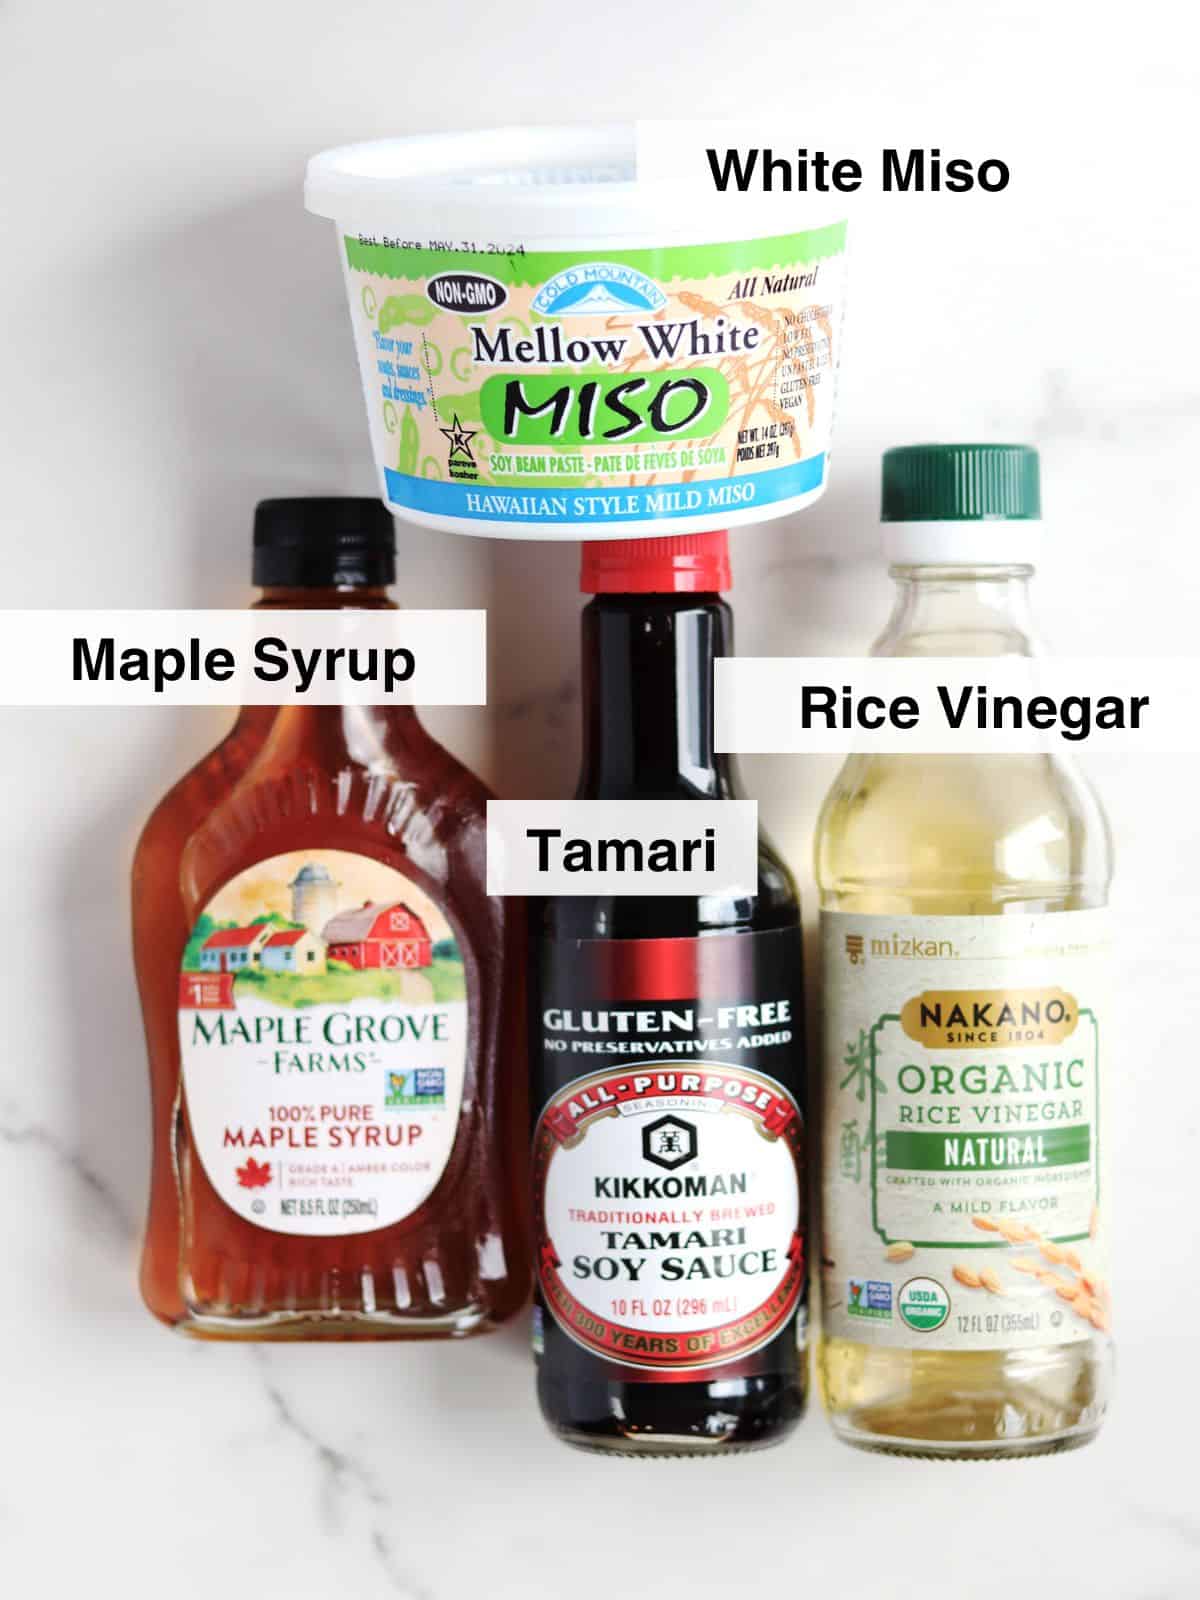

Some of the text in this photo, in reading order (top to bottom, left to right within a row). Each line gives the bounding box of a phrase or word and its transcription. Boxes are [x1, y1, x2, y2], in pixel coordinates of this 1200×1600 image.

[359, 233, 525, 257] Best Before MAY.31.2024
[435, 280, 497, 305] NON-GMO
[538, 267, 663, 308] COLD MOUNTAIN
[727, 265, 819, 300] All Natural
[471, 326, 628, 363] Mellow
[638, 318, 759, 359] White
[780, 378, 807, 394] GLUTEN
[504, 378, 710, 438] MISO
[779, 395, 802, 409] VEGAN
[454, 433, 464, 446] K
[490, 454, 513, 473] SOY
[516, 455, 546, 473] BEAN
[554, 455, 585, 473] PASTE
[594, 455, 622, 472] PATE
[626, 454, 640, 471] DE
[681, 451, 695, 467] DE
[699, 447, 726, 465] SOYA
[466, 483, 755, 516] HAWAIIAN STYLE MILD MISO
[192, 1011, 449, 1046] MAPLE GROVE
[543, 1000, 791, 1033] GLUTEN-FREE
[544, 1030, 792, 1054] NO PRESERVATIVES ADDED
[946, 1030, 1044, 1043] SINCE 1804
[897, 1058, 1085, 1095] ORGANIC
[567, 1073, 772, 1118] ALL-PURPOSE
[268, 1104, 374, 1123] 100% PURE
[899, 1099, 1083, 1125] RICE VINEGAR
[223, 1124, 423, 1148] MAPLE SYRUP
[944, 1135, 1048, 1167] NATURAL
[288, 1163, 328, 1174] GRADE
[349, 1162, 386, 1173] AMBER
[391, 1161, 431, 1172] COLOR
[288, 1176, 353, 1187] RICH TASTE
[594, 1172, 746, 1199] KIKKOMAN
[886, 1174, 935, 1187] CRAFTED
[939, 1174, 970, 1187] WITH
[976, 1174, 1029, 1187] ORGANIC
[281, 1198, 297, 1215] NET
[568, 1202, 776, 1224] TRADITIONALLY BREWED
[932, 1197, 1059, 1214] A MILD FLAVOR
[600, 1227, 746, 1250] TAMARI
[573, 1248, 777, 1281] SOY SAUCE
[611, 1299, 625, 1316] 10
[631, 1299, 648, 1317] FL
[653, 1299, 671, 1317] OZ
[677, 1298, 707, 1318] (296
[909, 1290, 937, 1302] USDA
[905, 1305, 942, 1318] ORGANIC
[957, 1315, 969, 1333] 12
[972, 1314, 983, 1333] FL
[986, 1314, 999, 1333] OZ
[610, 1328, 678, 1353] YEARS
[686, 1334, 714, 1352] OF
